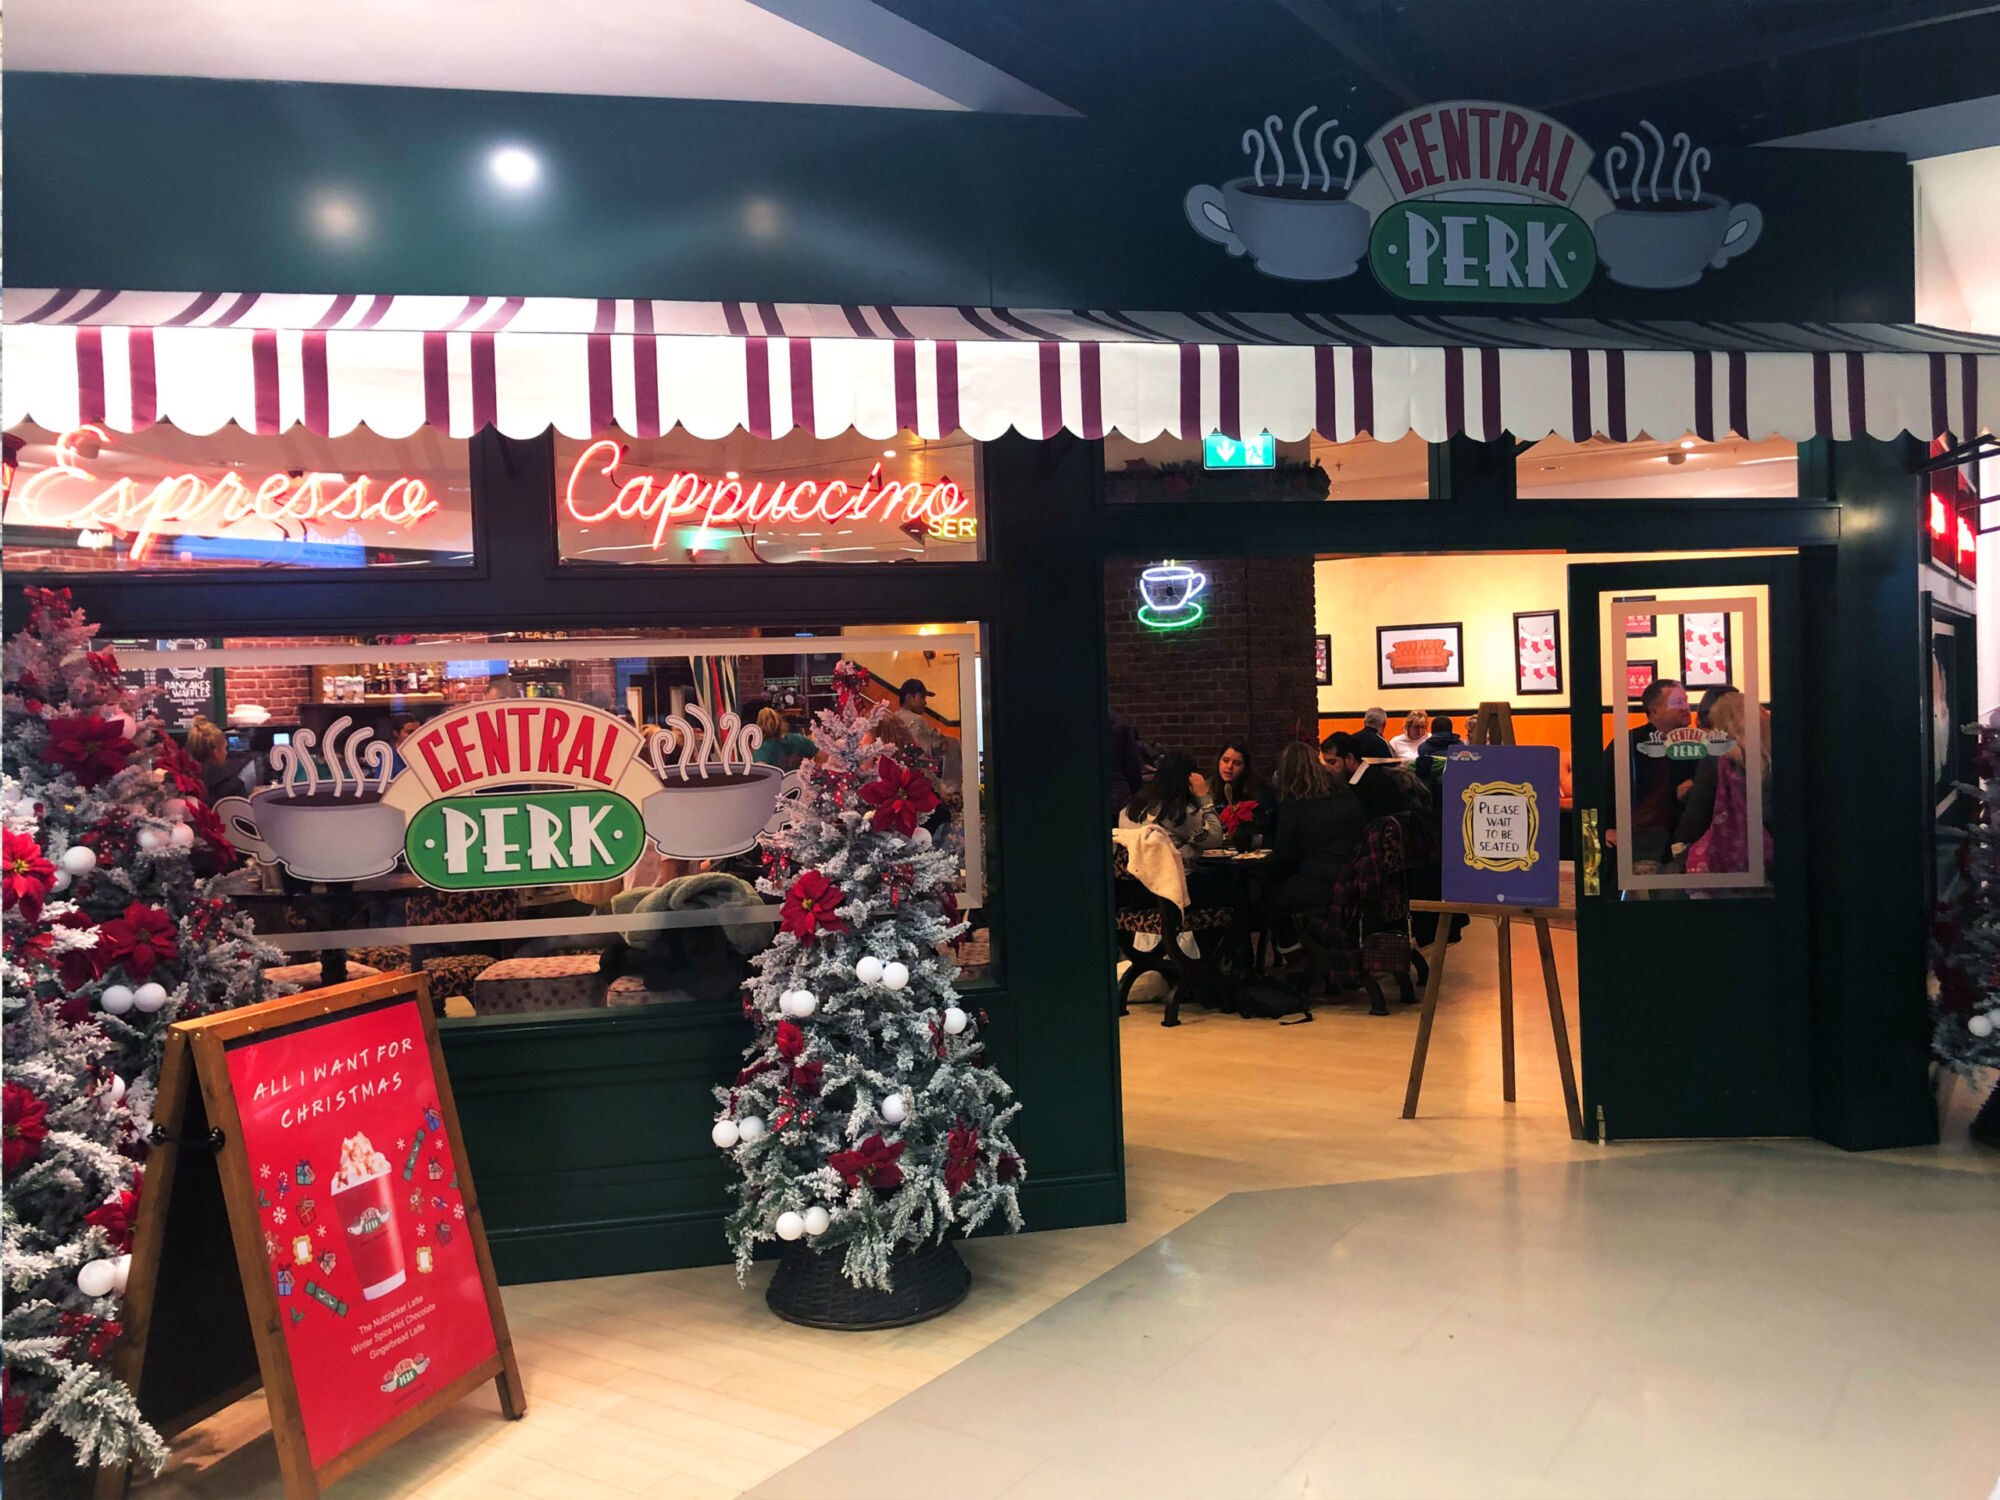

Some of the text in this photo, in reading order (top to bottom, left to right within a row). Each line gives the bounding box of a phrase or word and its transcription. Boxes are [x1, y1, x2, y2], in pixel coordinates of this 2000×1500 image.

[1382, 108, 1574, 200] CENTRAL
[1405, 210, 1569, 289] PERK
[20, 424, 438, 560] Espresso
[567, 440, 968, 552] Cappuccino
[927, 518, 978, 538] SER
[164, 680, 211, 690] PANCAKES
[171, 688, 211, 698] WAFFLES
[416, 707, 620, 793] CENTRAL
[1670, 729, 1703, 743] CENTRAL
[1673, 745, 1702, 757] PERK
[1479, 801, 1520, 815] PLEASE
[1486, 817, 1513, 827] WAIT
[441, 803, 617, 874] PERK
[1479, 842, 1519, 852] SEATED
[1485, 829, 1513, 839] TO BE
[253, 1037, 413, 1101] ALL I WANT FOR
[281, 1071, 403, 1128] CHRISTMAS
[350, 1303, 436, 1355] Winter Spice Hot Chocolate
[358, 1295, 424, 1335] The Nutcracker Latte
[369, 1323, 426, 1360] Gingerbread Latte
